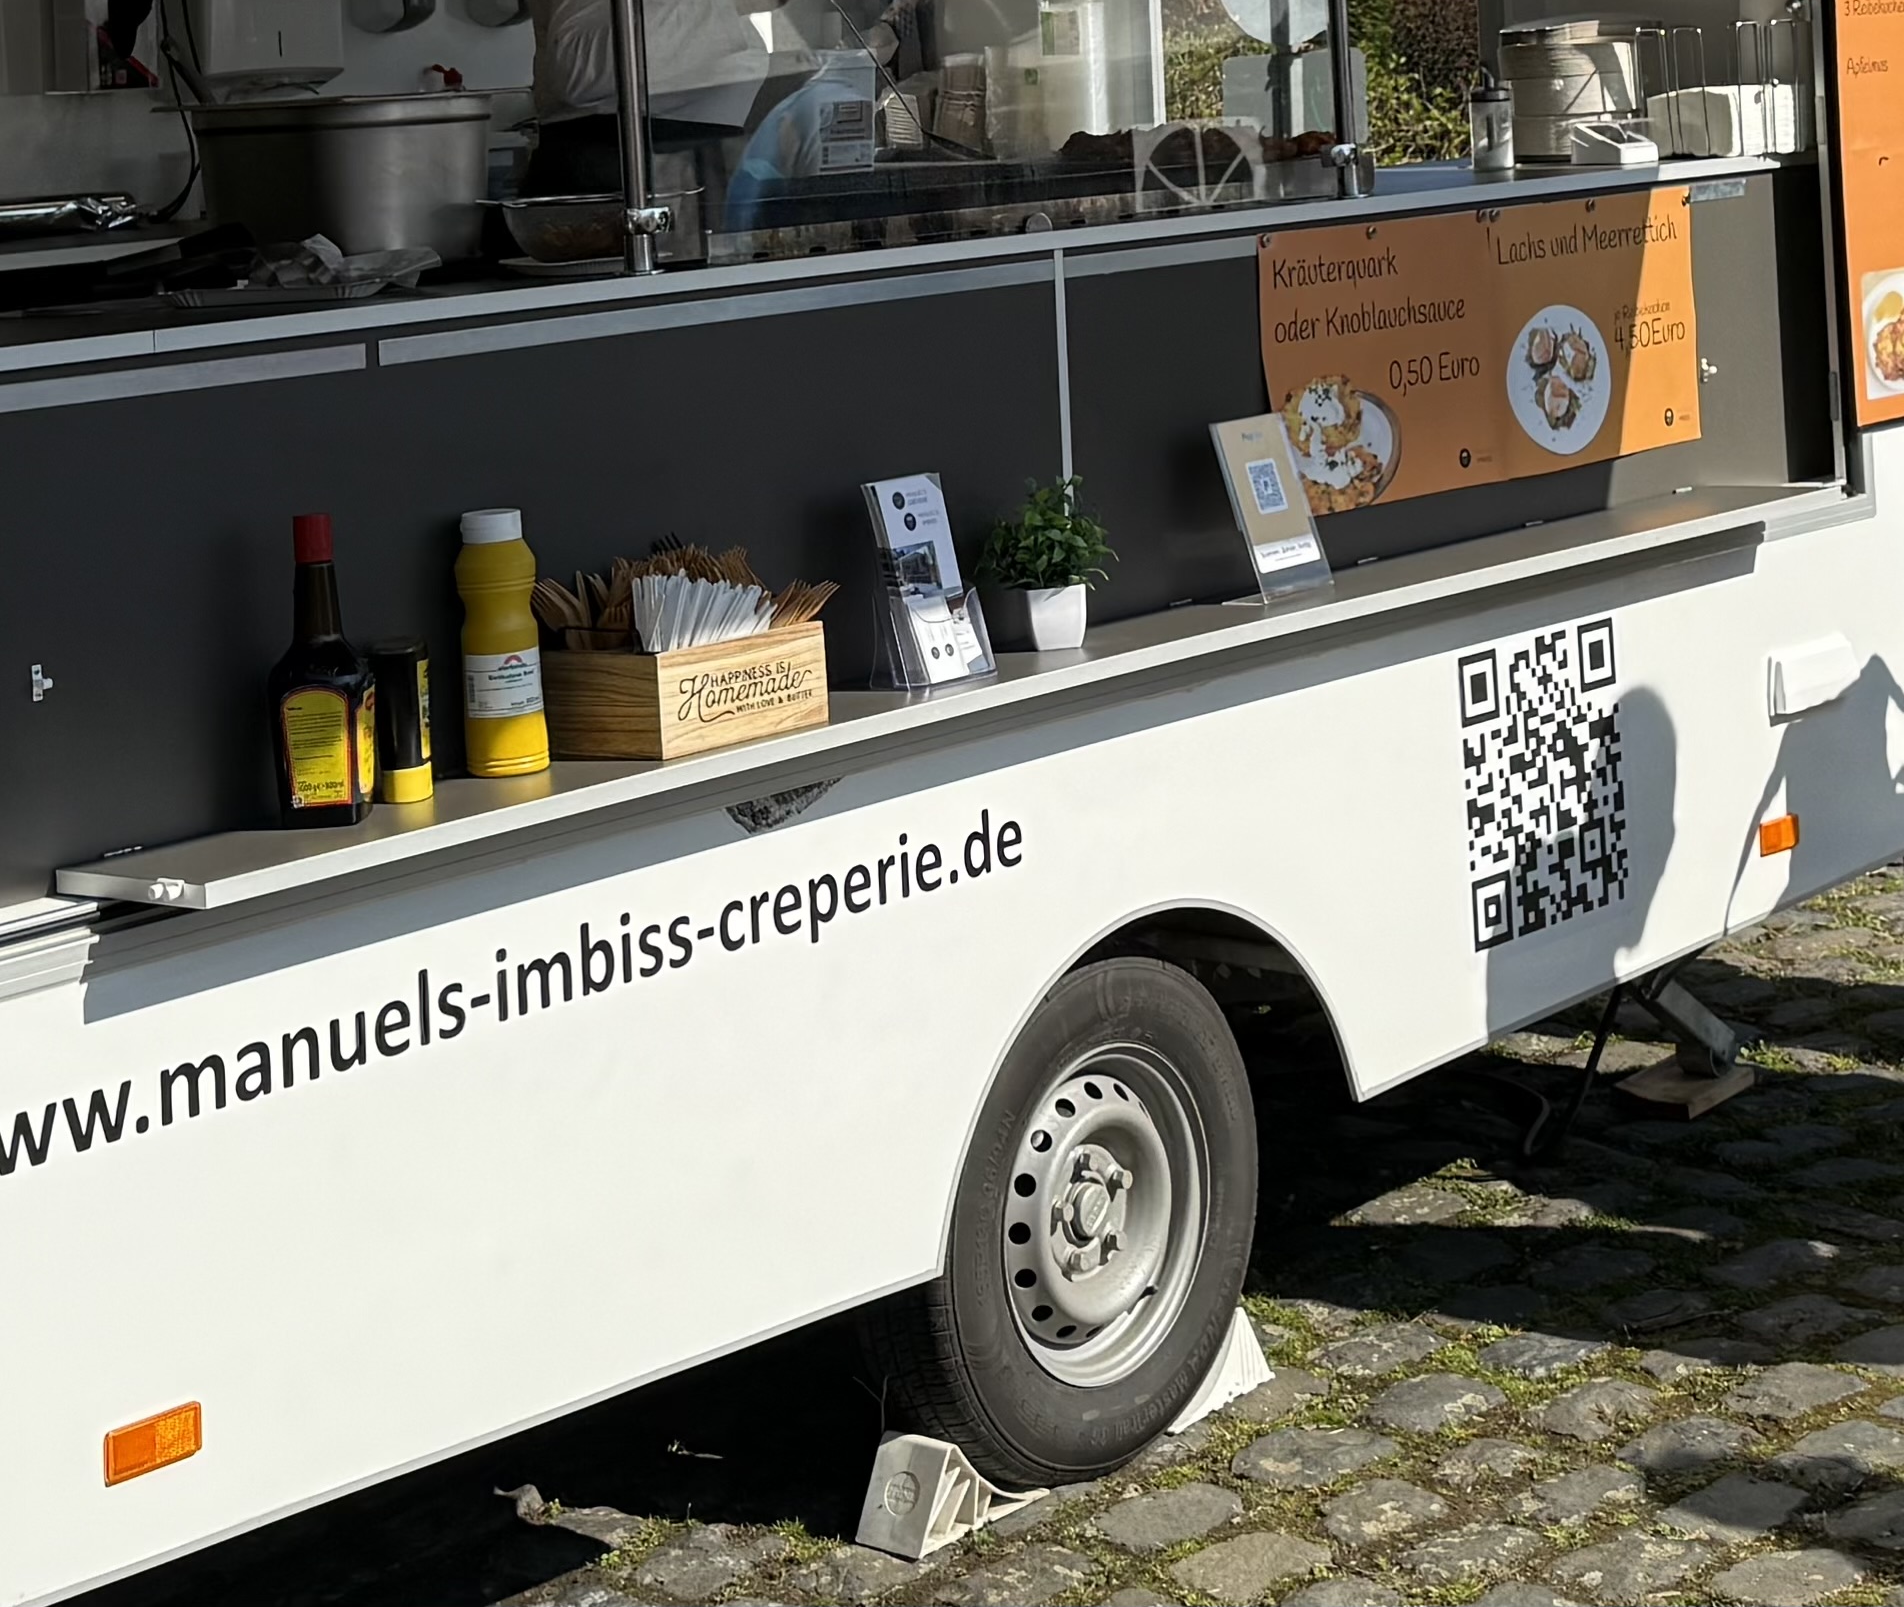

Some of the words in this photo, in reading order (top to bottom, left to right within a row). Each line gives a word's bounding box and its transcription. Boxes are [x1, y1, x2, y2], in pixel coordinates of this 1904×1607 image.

[1497, 230, 1546, 266] Lachs
[1550, 225, 1578, 256] und
[1583, 214, 1677, 253] Meerrettich
[1273, 247, 1398, 290] Kräuterquark
[1274, 308, 1321, 343] oder
[1325, 297, 1465, 339] Knoblauchsauce
[1651, 318, 1685, 345] Euro
[1389, 356, 1433, 397] 0,50
[1440, 352, 1480, 382] Euro
[678, 661, 812, 722] Homemade
[710, 665, 772, 688] HAPPINESS
[756, 697, 775, 710] LOVE
